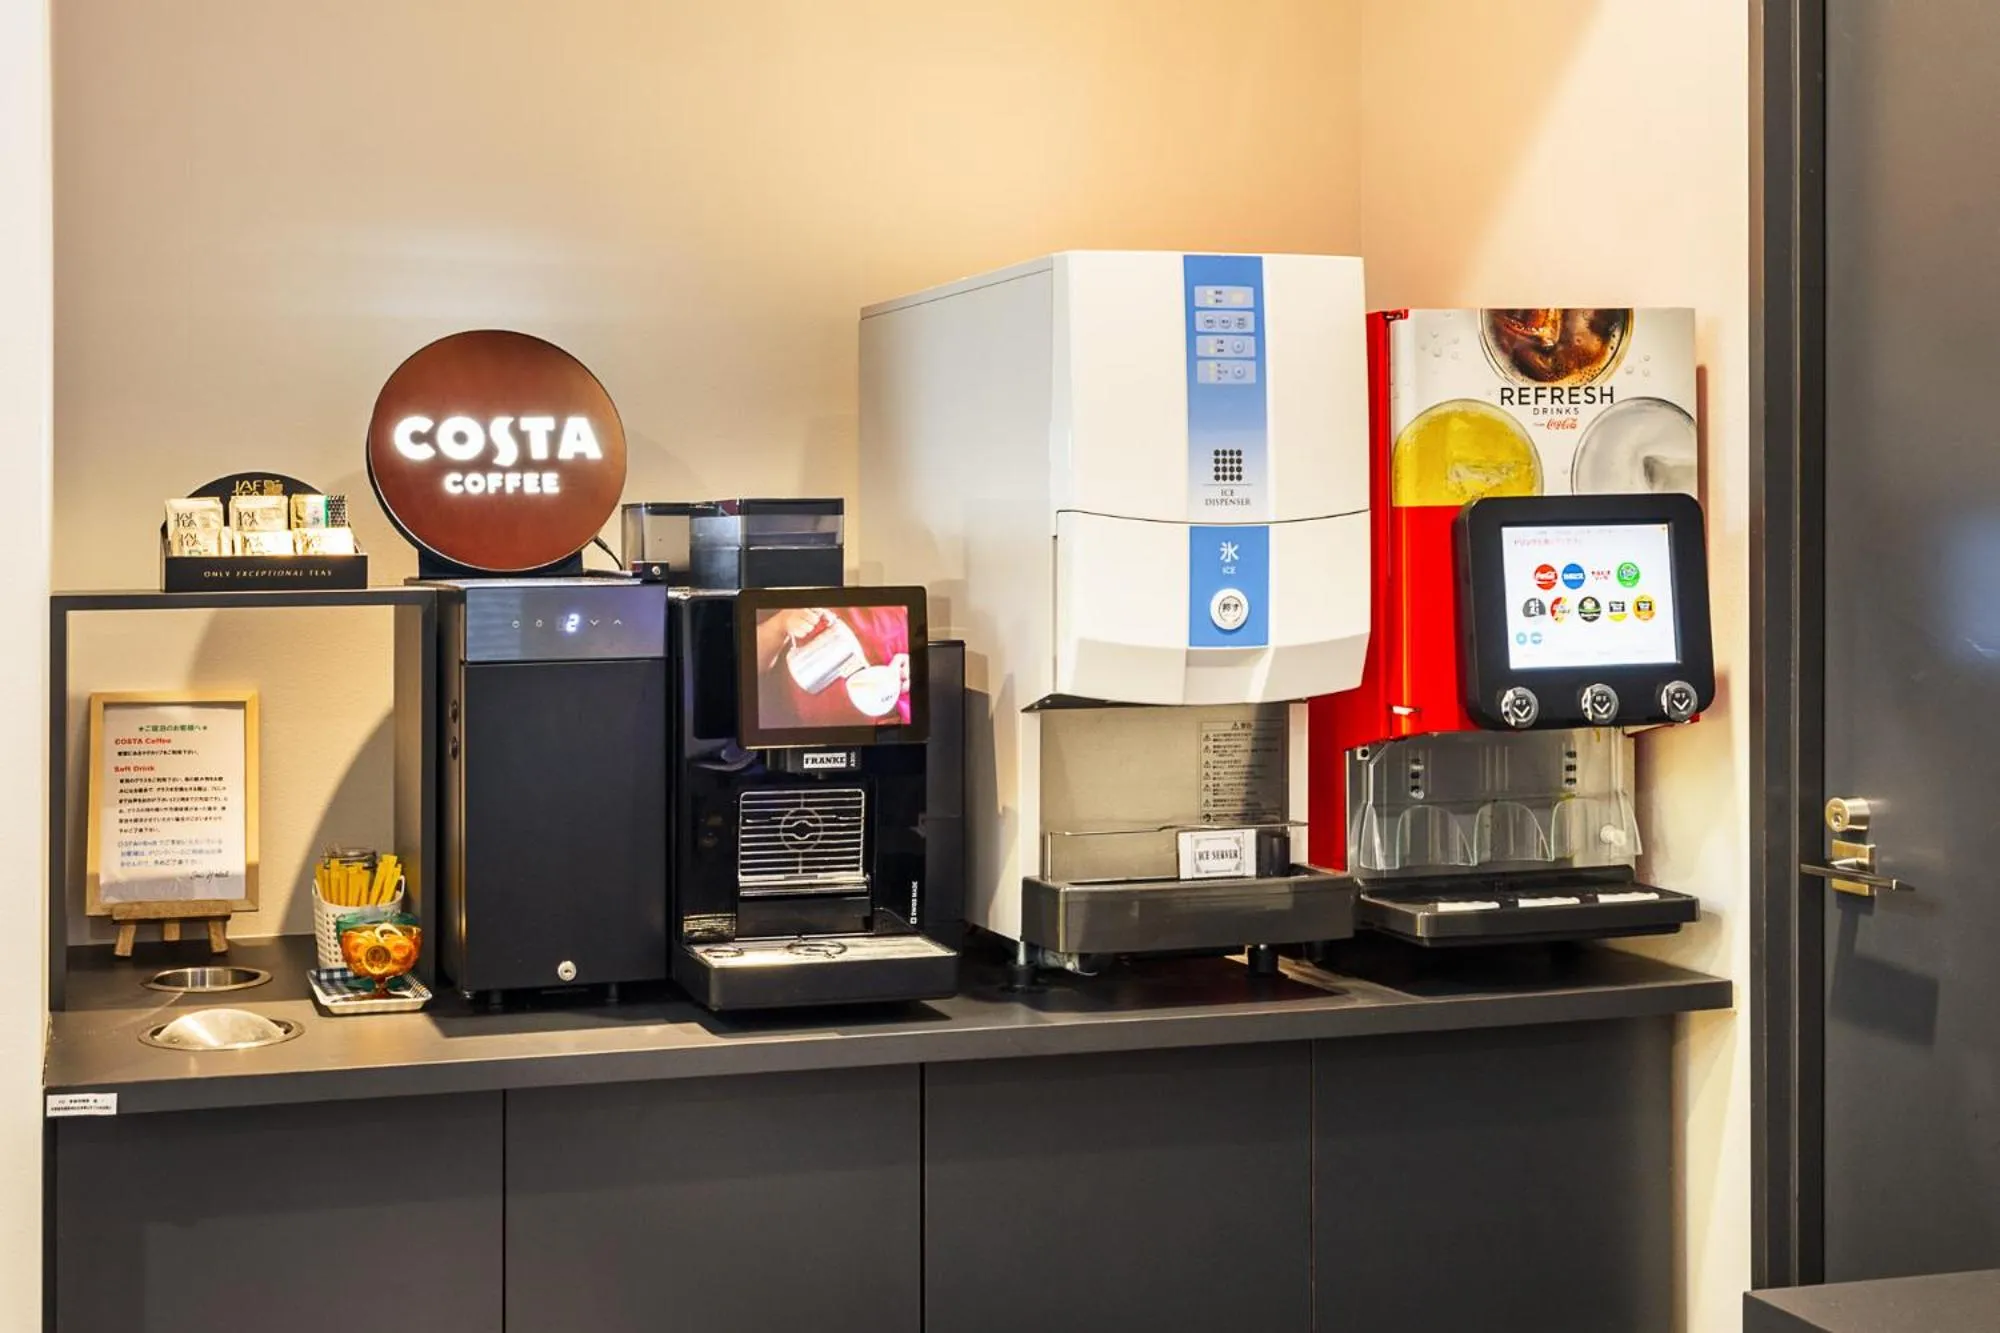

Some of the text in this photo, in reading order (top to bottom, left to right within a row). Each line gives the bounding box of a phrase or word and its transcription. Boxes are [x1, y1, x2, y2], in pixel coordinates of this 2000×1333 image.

[1500, 386, 1614, 405] REFRESH
[1533, 407, 1580, 415] DRINKS
[394, 416, 603, 467] COSTA
[232, 480, 261, 493] JAF
[443, 472, 560, 494] COFFEE
[1220, 489, 1235, 497] ICE
[1204, 497, 1251, 506] DISPENSER
[1219, 541, 1240, 563] 氷
[203, 568, 332, 578] ONLY EXCEPTIONAL TEAS
[1222, 566, 1236, 574] ICE
[566, 613, 580, 632] 2
[804, 756, 845, 765] FRANKE
[1198, 849, 1238, 860] ICE SERVER
